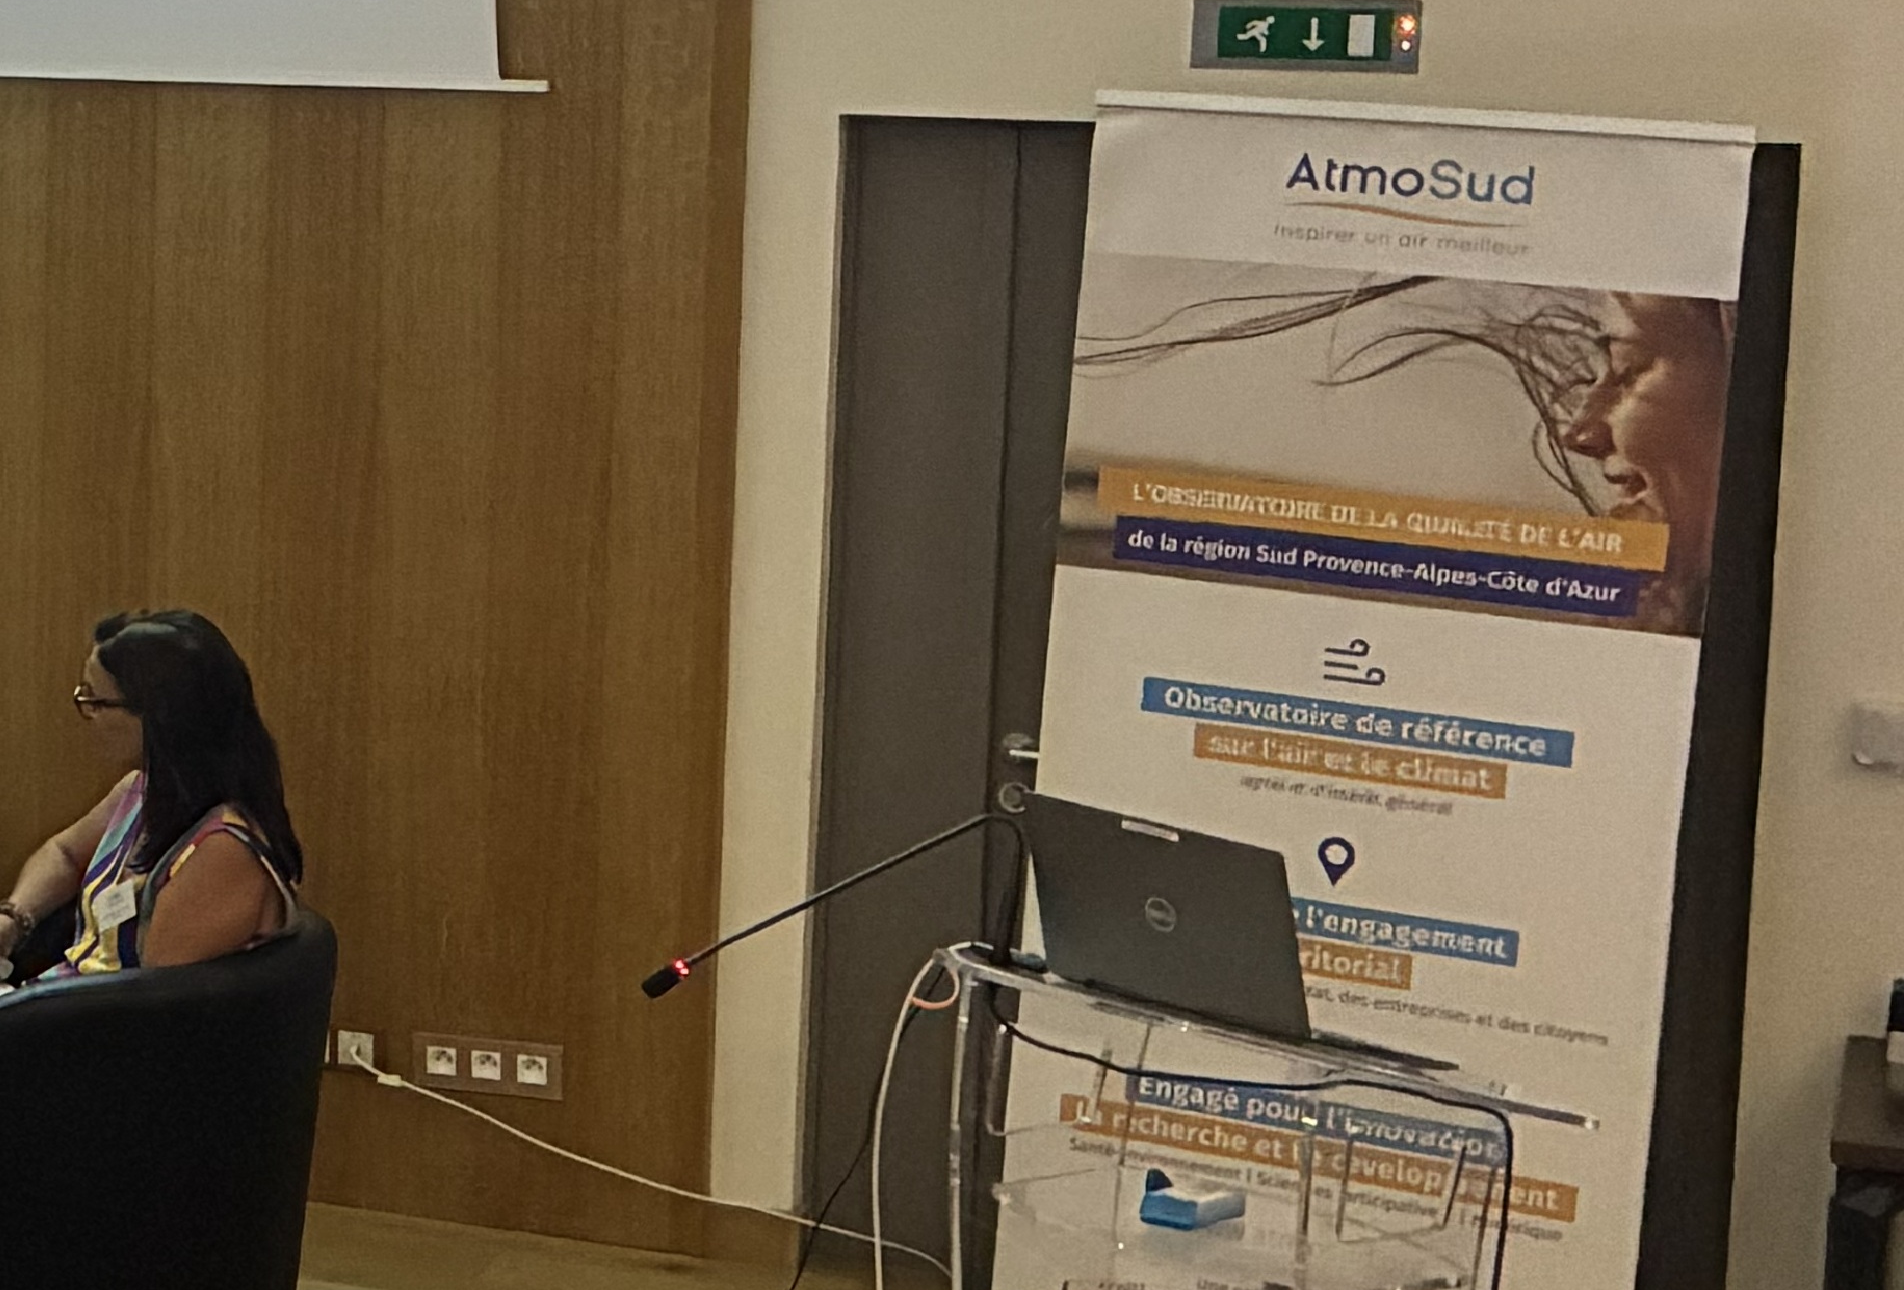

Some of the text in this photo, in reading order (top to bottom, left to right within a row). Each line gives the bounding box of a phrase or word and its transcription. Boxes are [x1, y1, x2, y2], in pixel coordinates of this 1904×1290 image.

[1286, 152, 1535, 205] AtmoSud
[1398, 231, 1428, 248] air
[1519, 523, 1553, 546] DE
[1128, 529, 1621, 602] de la région Sud Provence-Alpes-Côte d'Azur
[1164, 685, 1547, 758] Observatoire de référence
[1395, 758, 1492, 790] climat
[1306, 905, 1508, 959] l'engagement
[1297, 943, 1402, 982] ritorial
[1138, 1075, 1240, 1110] Engagé
